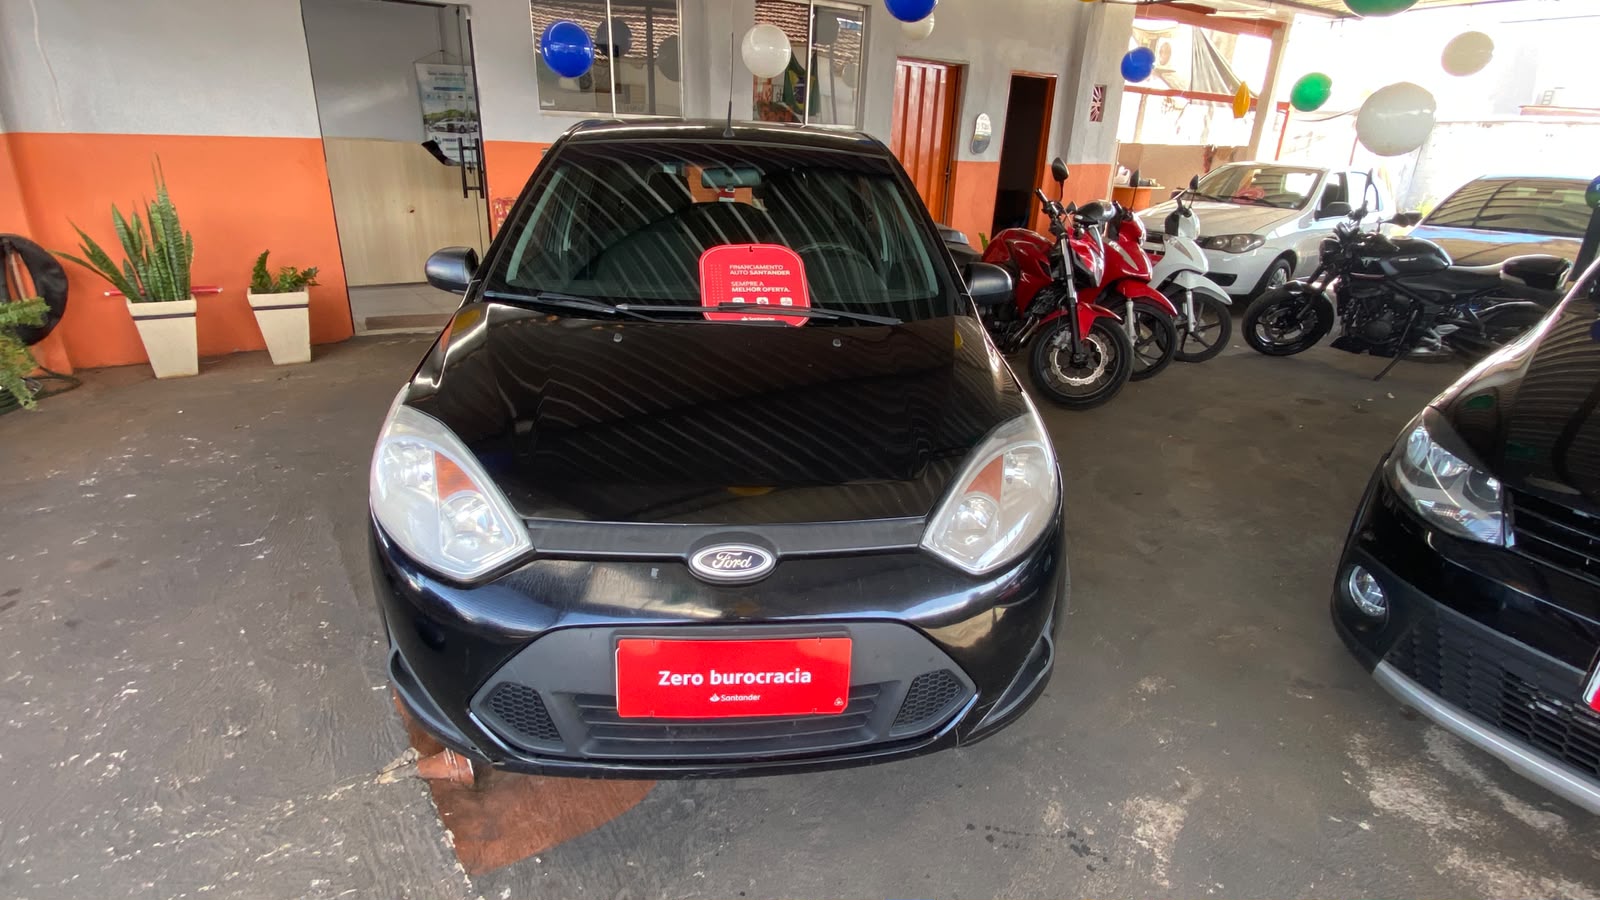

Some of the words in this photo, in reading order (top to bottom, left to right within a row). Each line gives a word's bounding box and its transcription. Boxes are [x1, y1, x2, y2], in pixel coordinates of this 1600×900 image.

[712, 551, 752, 568] Ford
[658, 670, 704, 686] Zero
[709, 668, 812, 685] burocracia
[720, 693, 761, 702] Santander
